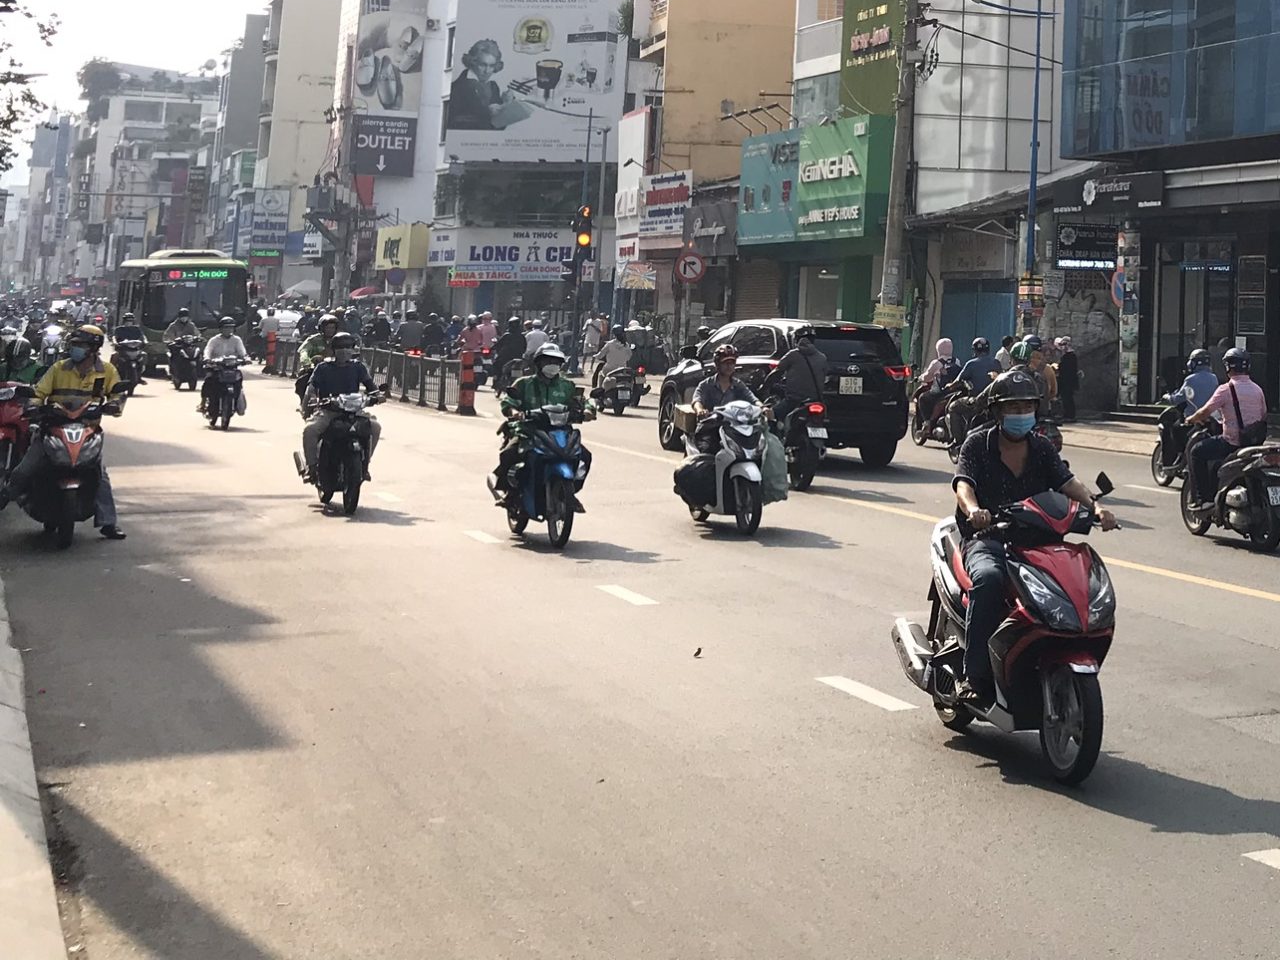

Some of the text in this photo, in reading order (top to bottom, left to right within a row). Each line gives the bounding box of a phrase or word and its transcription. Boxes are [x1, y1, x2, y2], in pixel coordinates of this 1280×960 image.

[357, 135, 412, 151] OUTLET
[583, 207, 590, 217] 2
[468, 245, 520, 262] LONG
[526, 241, 541, 262] Á
[545, 244, 597, 263] CHU
[454, 271, 477, 280] MUA
